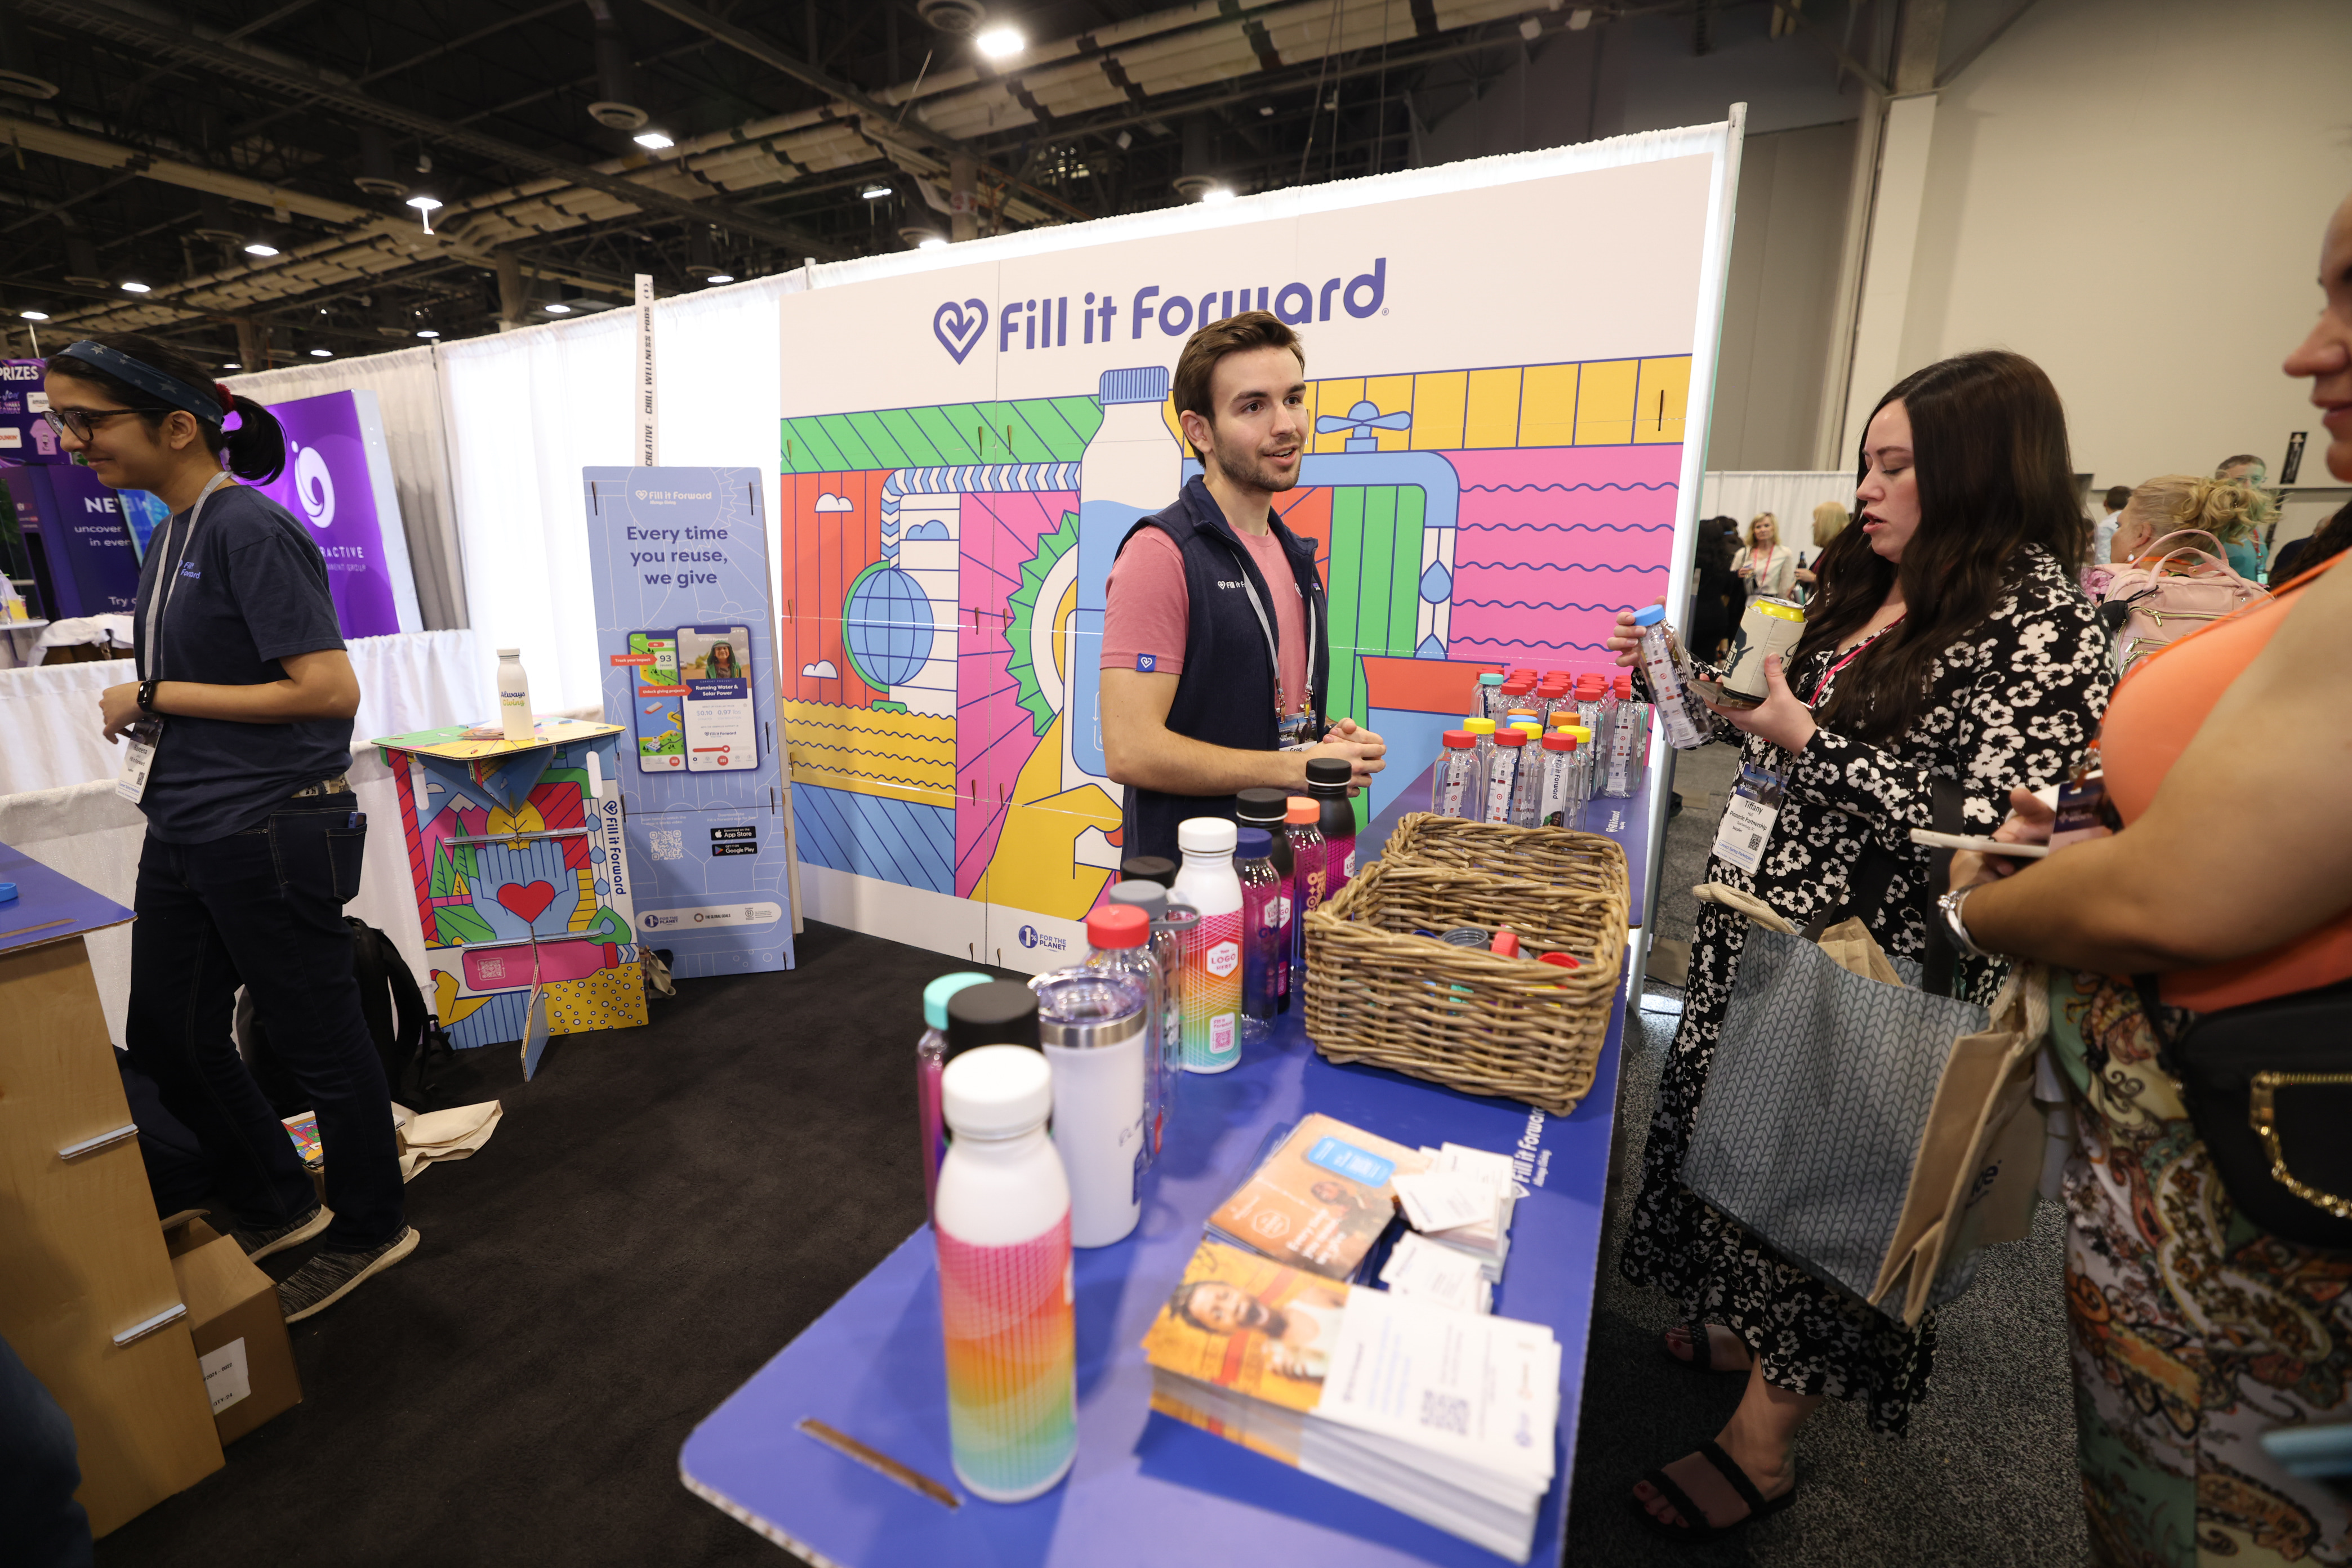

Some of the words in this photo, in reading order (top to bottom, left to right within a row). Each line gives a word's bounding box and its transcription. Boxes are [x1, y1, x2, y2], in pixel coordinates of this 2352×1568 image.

[1000, 296, 1067, 353] Fill
[1084, 292, 1117, 344] it
[1132, 257, 1387, 339] Forward
[649, 491, 663, 500] Fill
[665, 491, 671, 500] it
[673, 491, 712, 500] Forward
[84, 497, 118, 513] NE
[74, 525, 122, 533] uncover
[627, 527, 680, 544] Every
[685, 525, 728, 540] time
[89, 537, 101, 546] in
[319, 546, 364, 559] RACTIVE
[630, 551, 665, 567] you
[671, 551, 728, 564] reuse,
[644, 574, 671, 585] we
[677, 570, 717, 589] give
[108, 596, 128, 607] Try
[1744, 786, 1758, 795] WICHITA
[1745, 800, 1763, 815] Tiffany
[1610, 810, 1620, 822] Forward
[1730, 810, 1745, 821] Pinnacle
[1745, 818, 1767, 831] Partnership
[606, 818, 619, 834] Fill
[1719, 841, 1729, 850] Connect
[1738, 851, 1754, 861] Marketplace
[610, 848, 626, 895] Forward
[1025, 927, 1037, 947] 1%
[1040, 939, 1066, 951] PLANET
[1211, 953, 1236, 965] LOGO
[1517, 1106, 1545, 1151] Forwar
[1514, 1149, 1536, 1162] it
[1512, 1159, 1534, 1183] Fill
[221, 1363, 233, 1371] 0022
